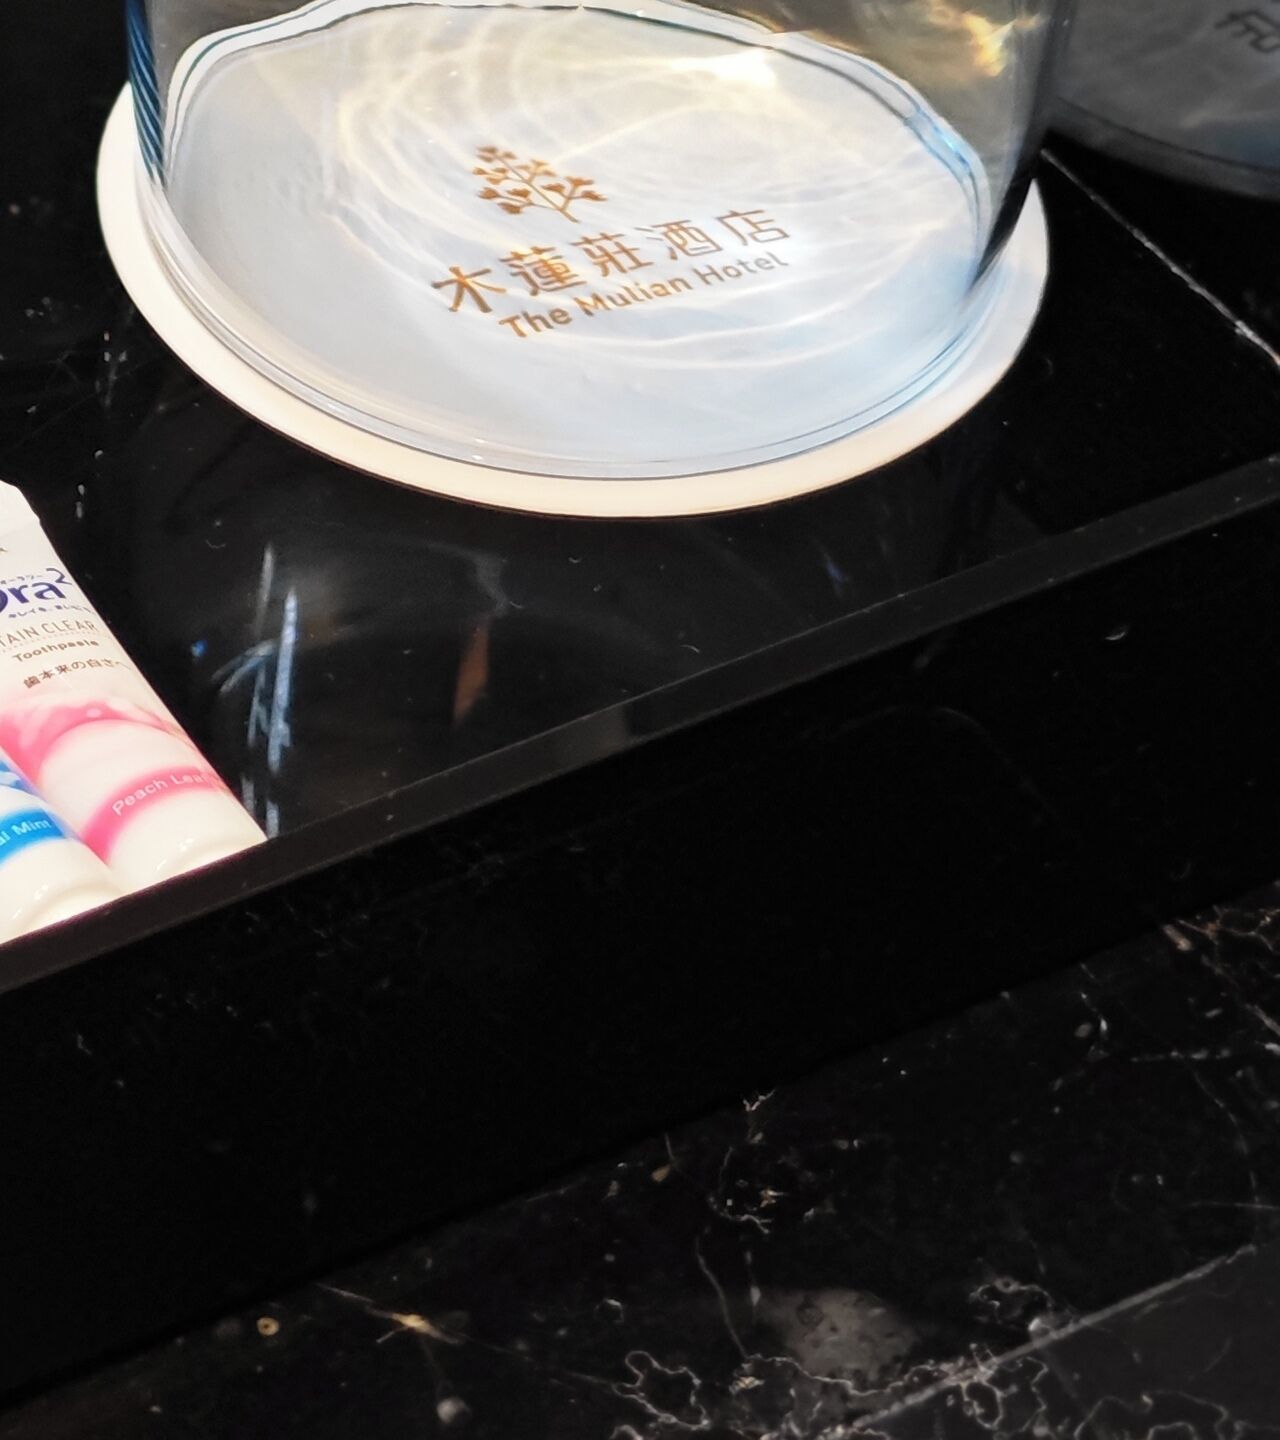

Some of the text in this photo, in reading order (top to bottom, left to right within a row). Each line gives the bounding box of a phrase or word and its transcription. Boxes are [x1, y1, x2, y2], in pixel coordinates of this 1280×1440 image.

[431, 208, 791, 314] 木蓮莊酒店
[498, 252, 790, 339] The Mulian Hotel
[41, 618, 98, 635] CLEAR
[12, 638, 100, 663] Toothpaste
[112, 778, 168, 817] Peach
[10, 818, 53, 837] Mint
